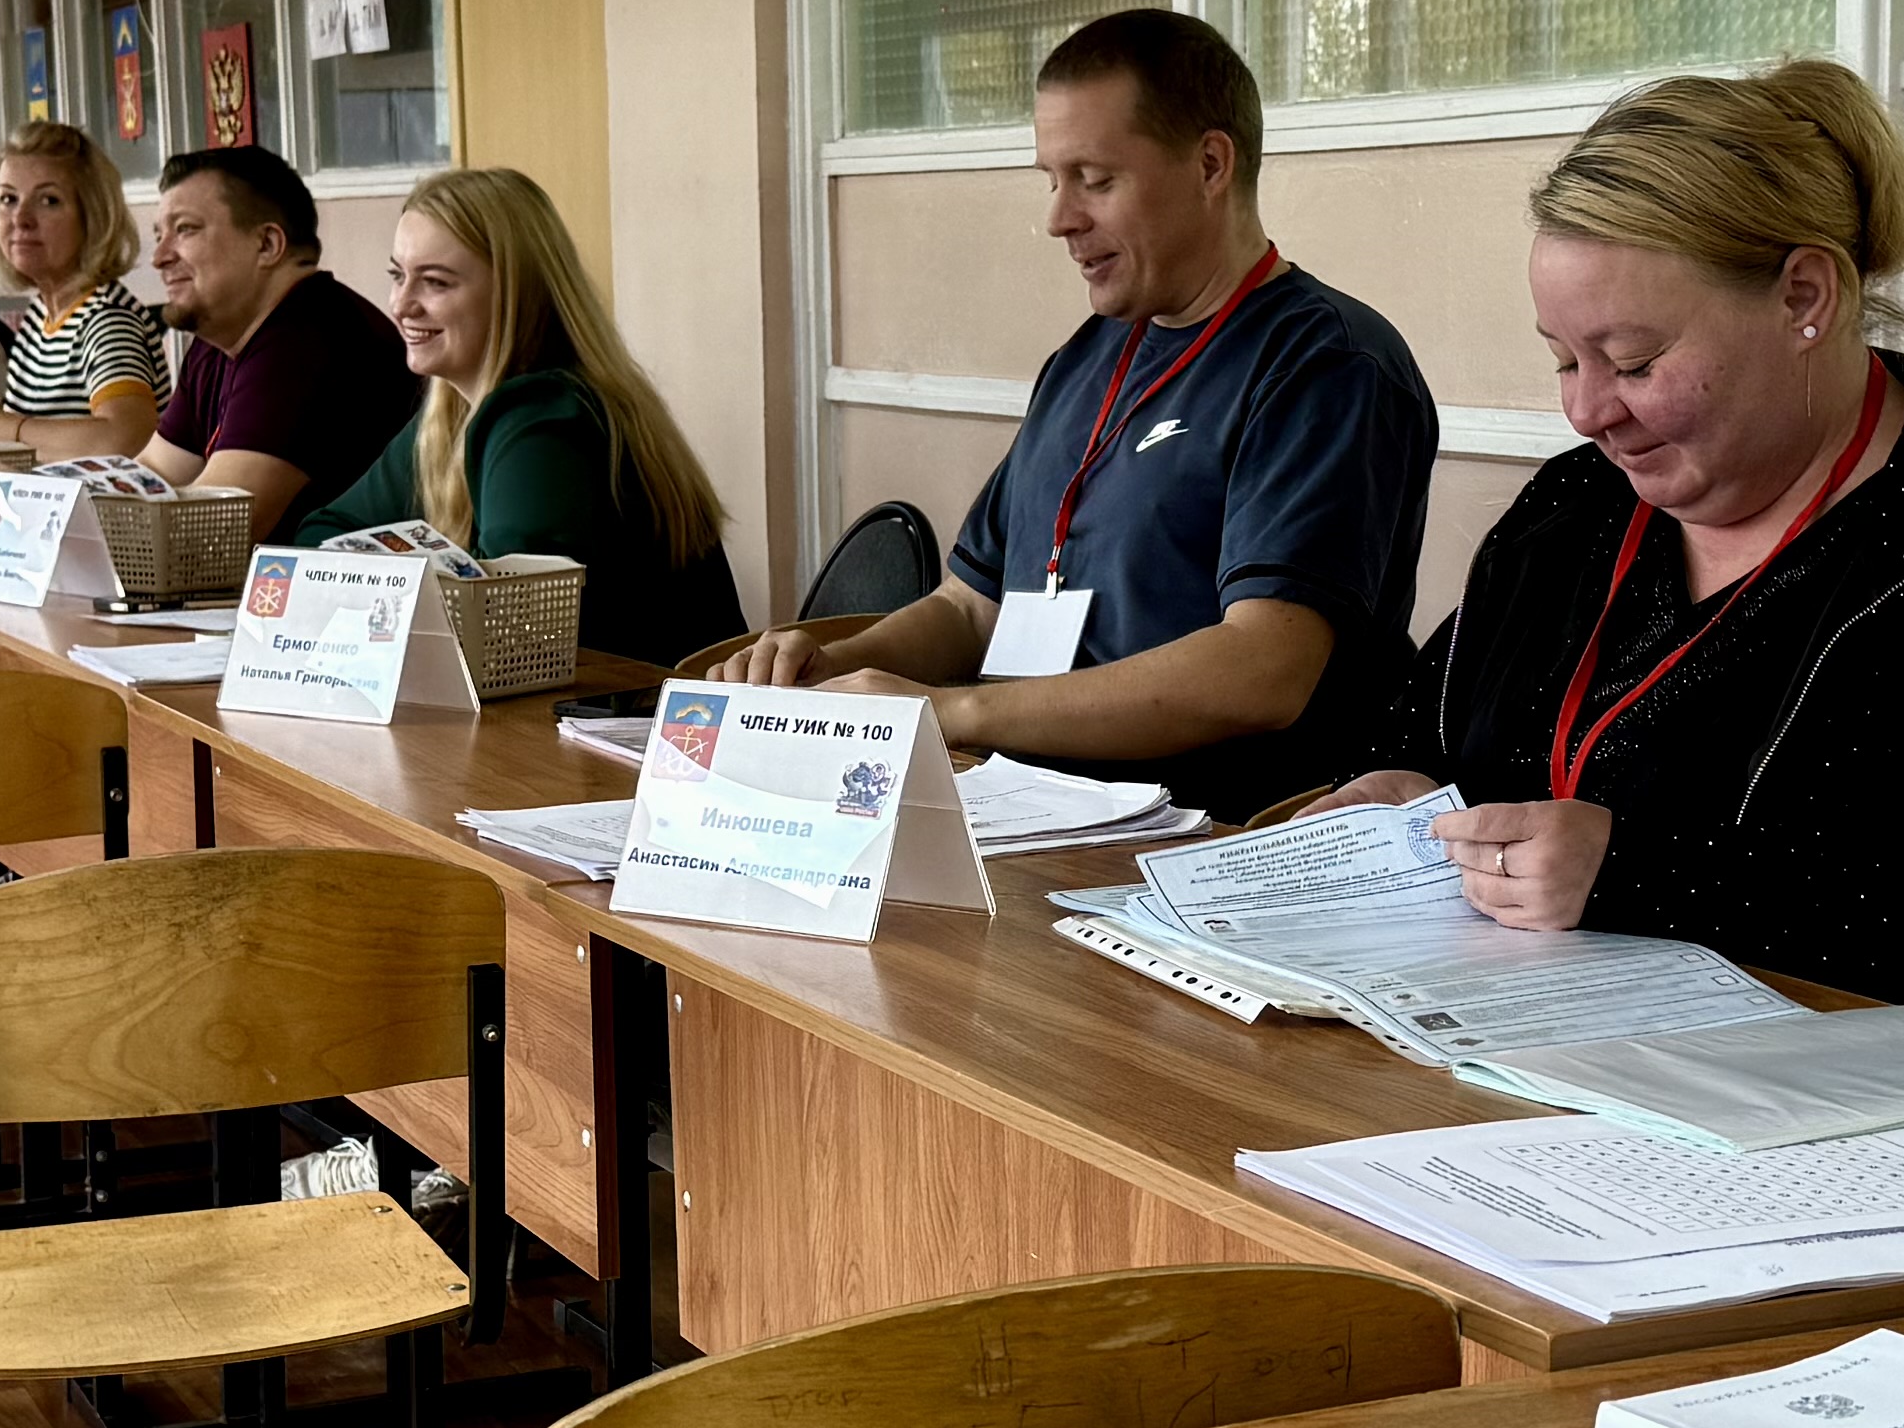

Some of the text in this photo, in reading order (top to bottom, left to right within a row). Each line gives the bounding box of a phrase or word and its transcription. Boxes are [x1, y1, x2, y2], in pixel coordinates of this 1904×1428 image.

[305, 570, 337, 583] ЧЛЕН
[341, 572, 363, 585] УИК
[386, 575, 406, 588] 100
[241, 665, 292, 682] Наталья
[739, 713, 893, 741] ЧЛЕН УИК № 100
[700, 806, 814, 839] Инюшева
